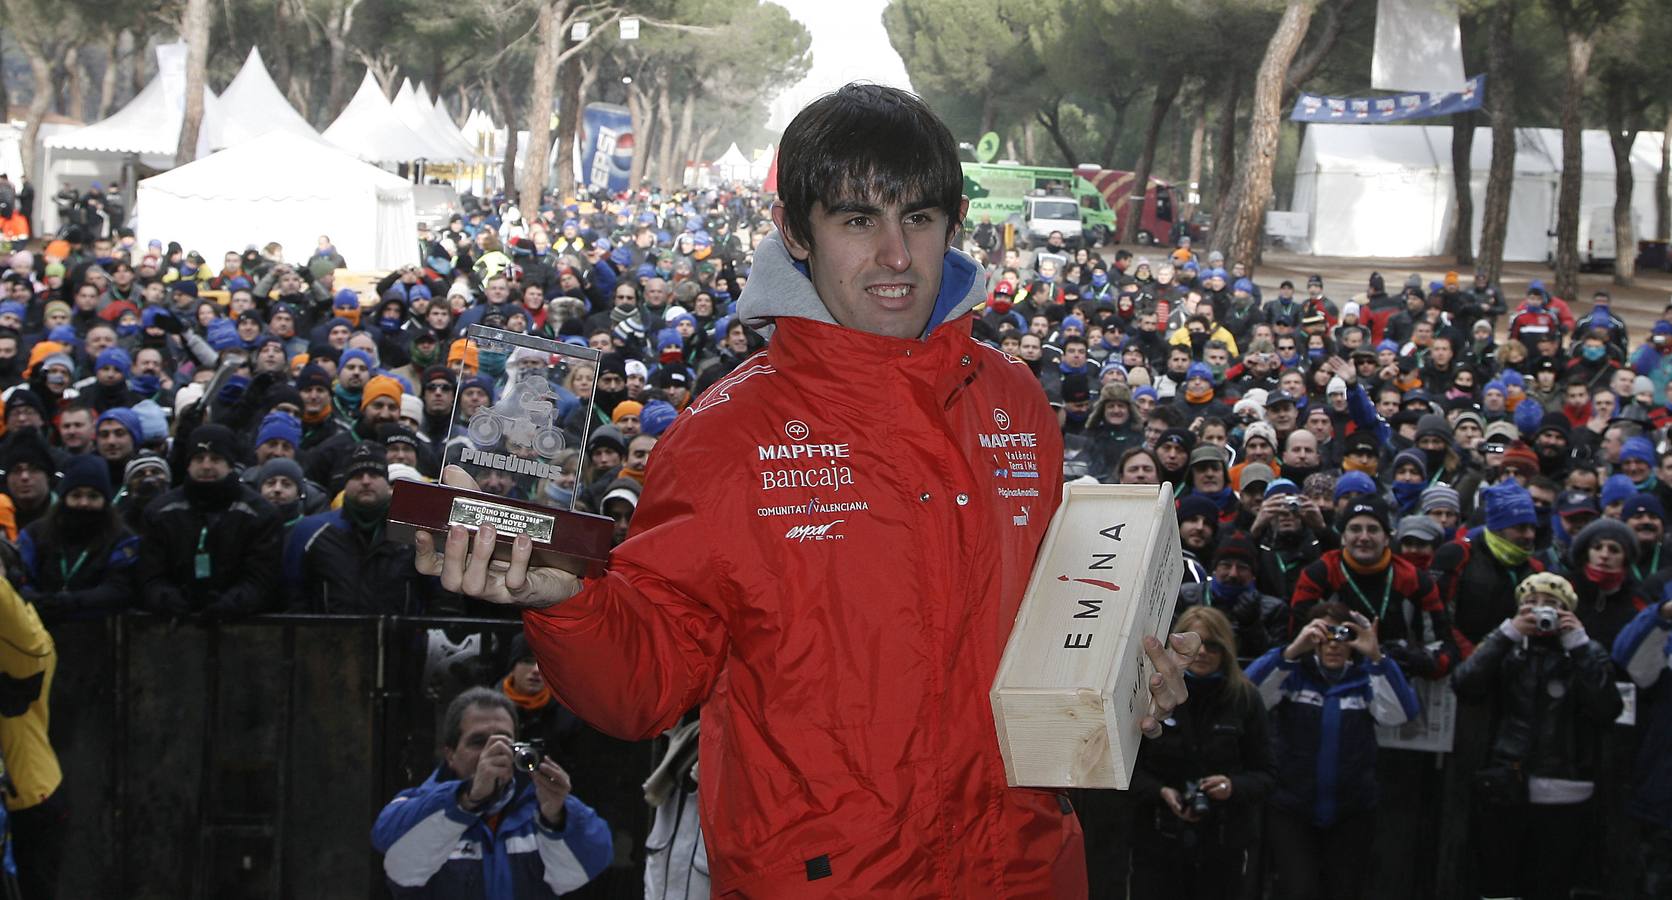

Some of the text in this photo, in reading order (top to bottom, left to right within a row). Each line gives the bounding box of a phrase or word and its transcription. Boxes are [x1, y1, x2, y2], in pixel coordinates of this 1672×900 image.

[978, 432, 1037, 448] MAPFRE
[758, 443, 849, 461] MAPFRE
[461, 448, 562, 480] PINGÜINOS
[761, 459, 855, 492] Bancaja
[757, 501, 868, 517] COMUNITAT VALENCIANA
[475, 513, 501, 524] DENNIS
[502, 519, 527, 529] NOYES
